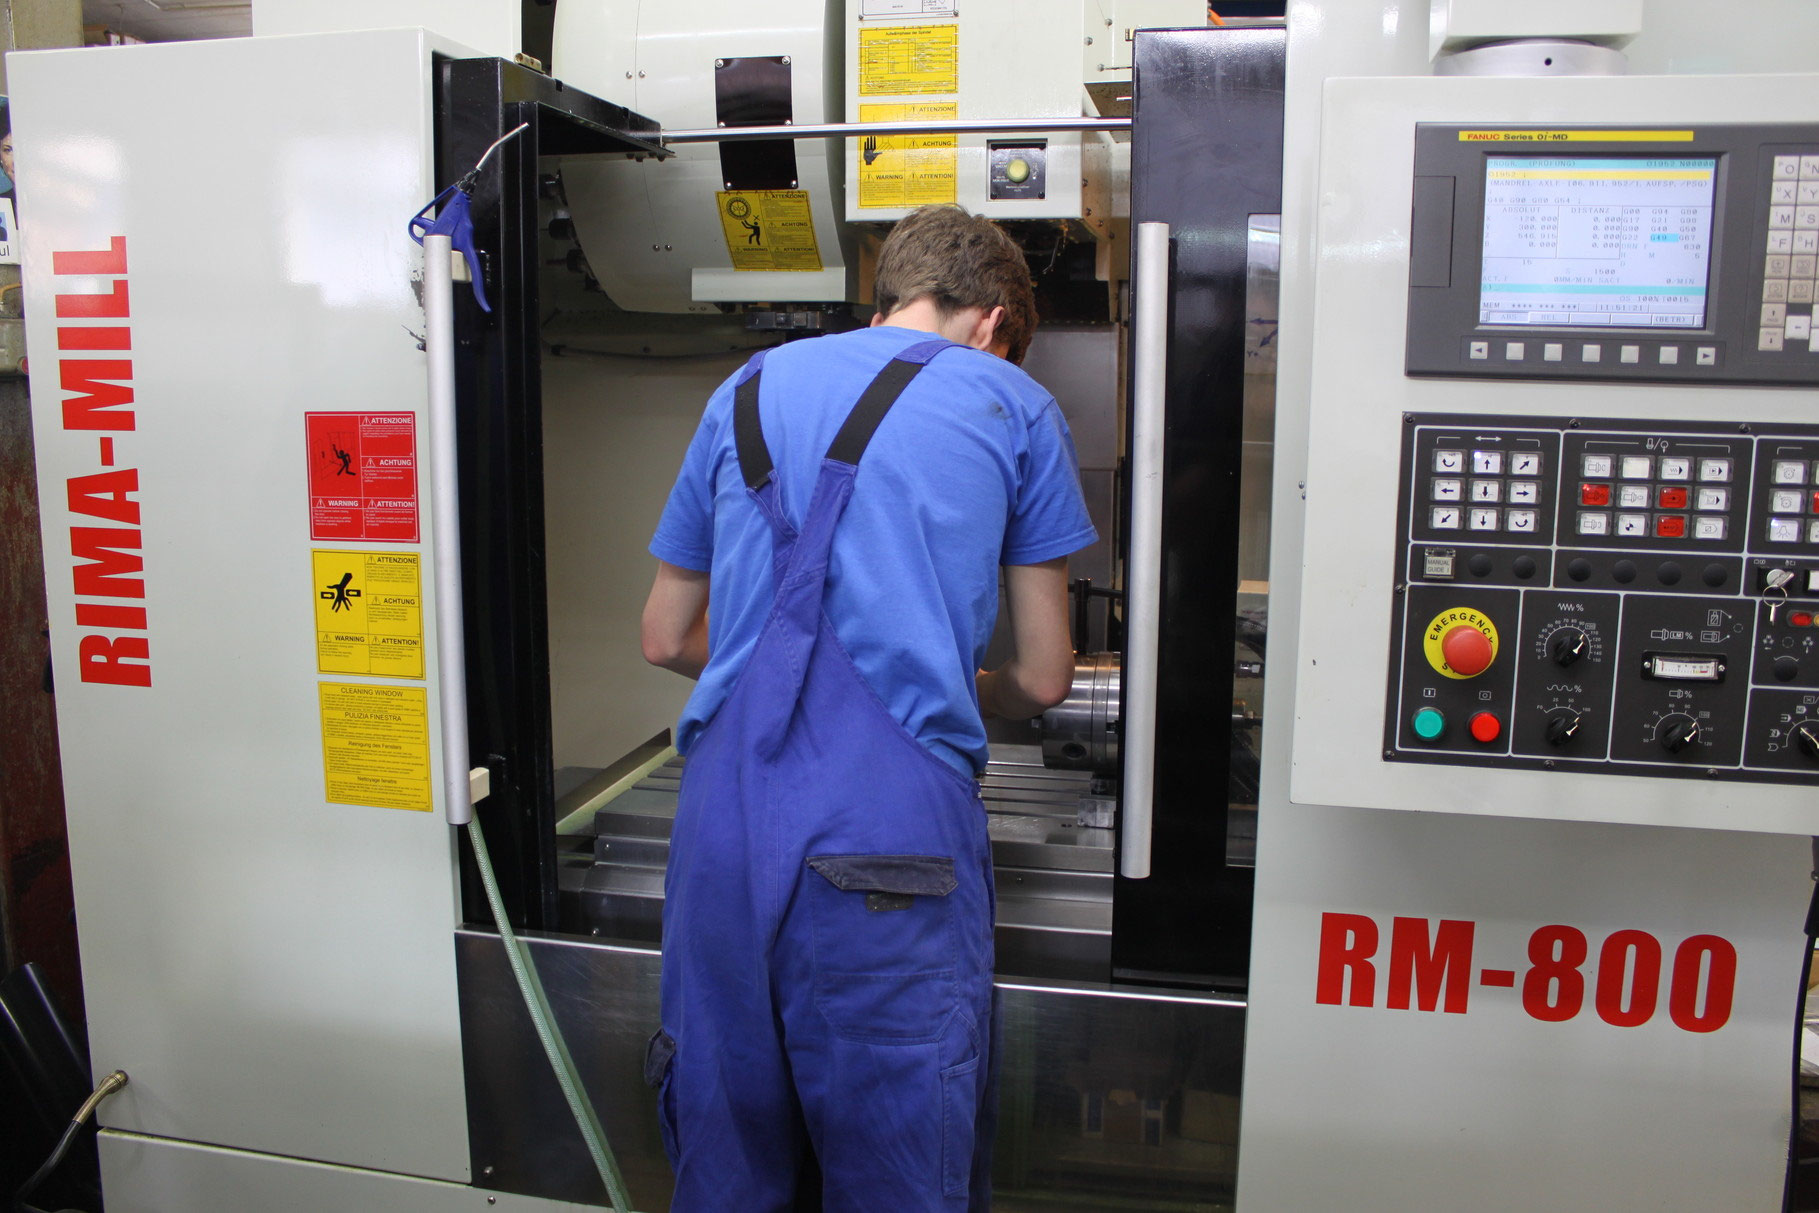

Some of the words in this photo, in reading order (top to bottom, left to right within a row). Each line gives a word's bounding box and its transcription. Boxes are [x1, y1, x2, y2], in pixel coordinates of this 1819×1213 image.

[1785, 165, 1794, 174] O
[1812, 165, 1819, 174] N
[1784, 190, 1791, 199] X
[1810, 190, 1818, 199] Y
[1781, 214, 1790, 223] M
[1807, 215, 1815, 223] S
[1779, 239, 1787, 248] F
[52, 236, 152, 687] RIMA-MILL
[1316, 912, 1738, 1033] RM-800
